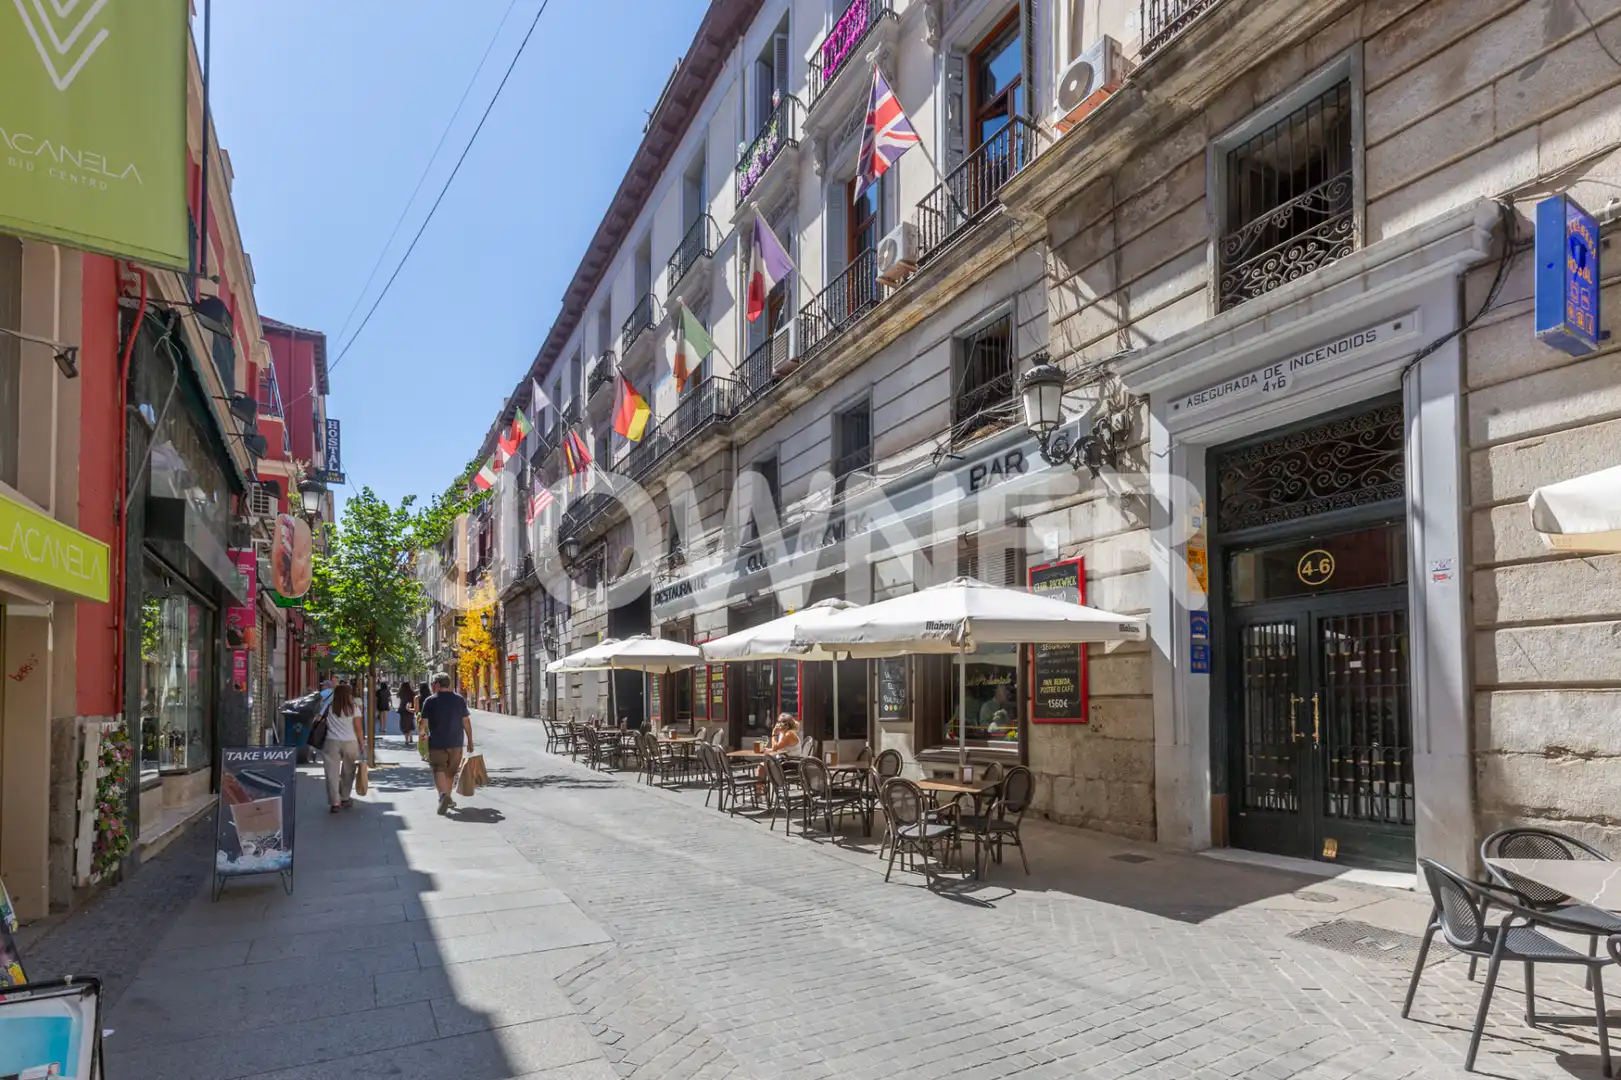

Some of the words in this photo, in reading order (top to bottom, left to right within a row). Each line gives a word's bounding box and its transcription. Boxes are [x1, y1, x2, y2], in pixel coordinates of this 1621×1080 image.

[48, 167, 108, 191] CENTRO
[1186, 373, 1258, 409] ASEGURADA
[1263, 363, 1284, 381] DE
[1289, 329, 1377, 372] INCENDIOS
[327, 419, 339, 472] HOSTAL
[969, 450, 1027, 491] BAR
[1301, 558, 1331, 576] 4-6
[925, 620, 955, 631] Mahou
[225, 751, 260, 762] TAKE
[262, 750, 294, 761] WAY
